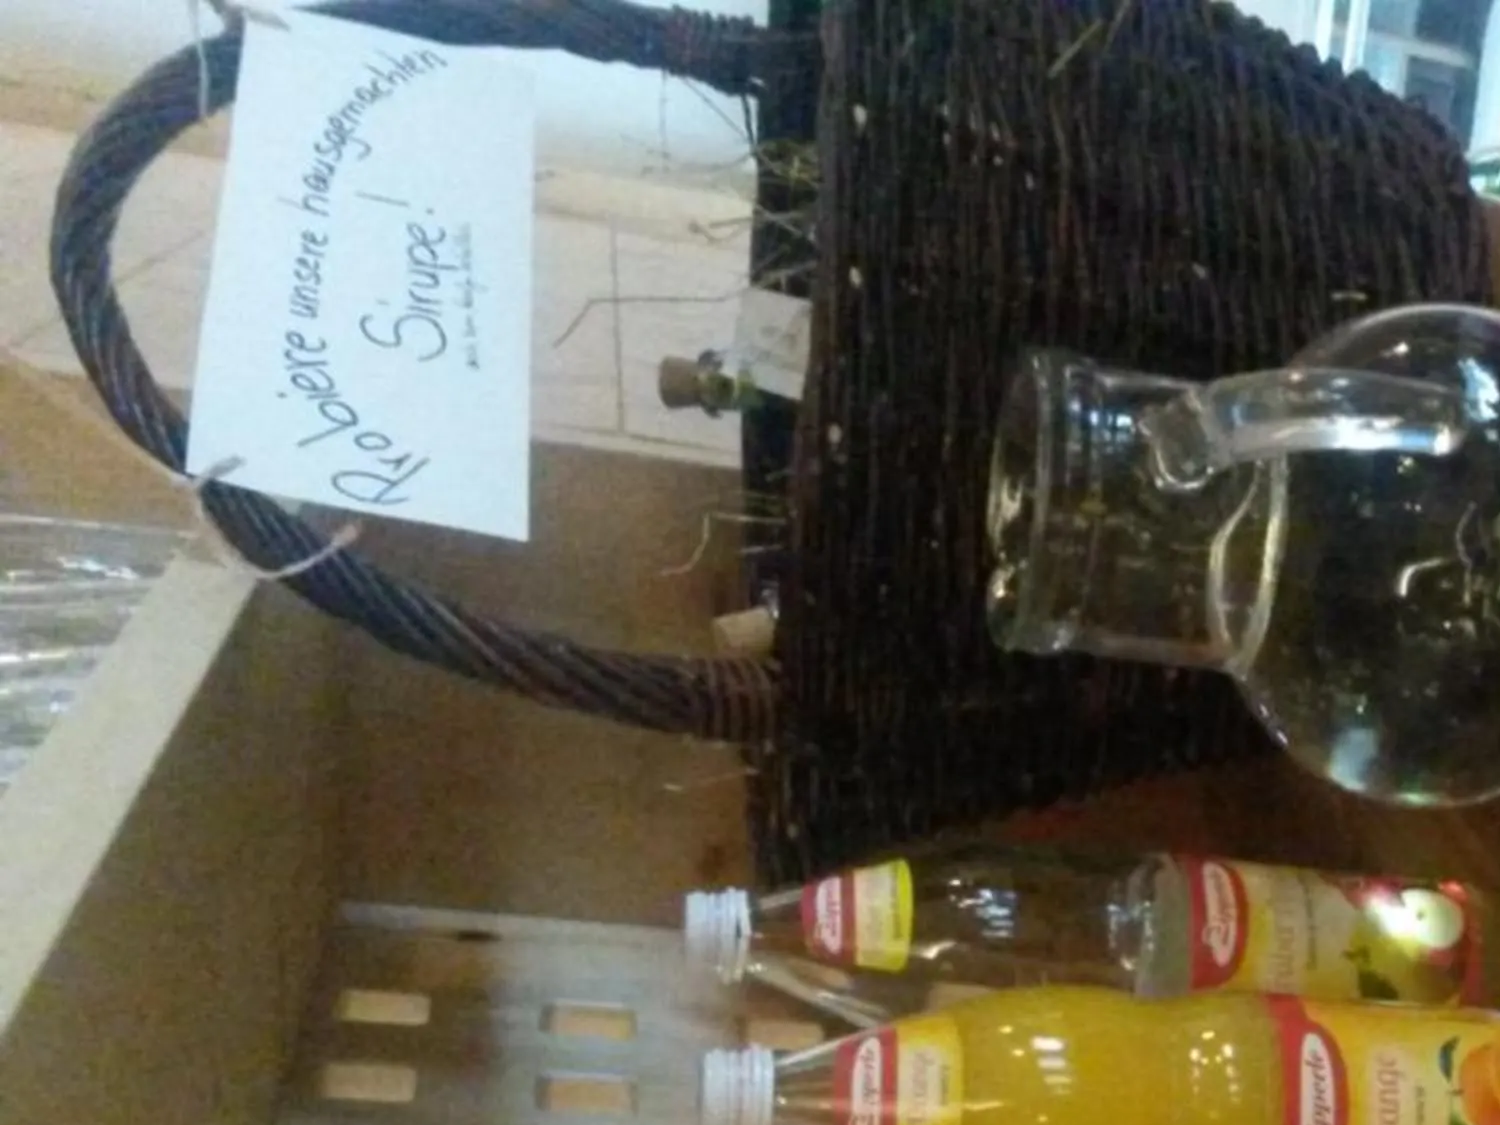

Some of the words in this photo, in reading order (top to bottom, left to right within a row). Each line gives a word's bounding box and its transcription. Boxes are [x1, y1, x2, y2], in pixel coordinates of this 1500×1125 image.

[276, 47, 449, 218] hausgemachten
[286, 231, 330, 318] unsere
[354, 189, 459, 362] Sirupe!
[276, 329, 430, 506] Probiere
